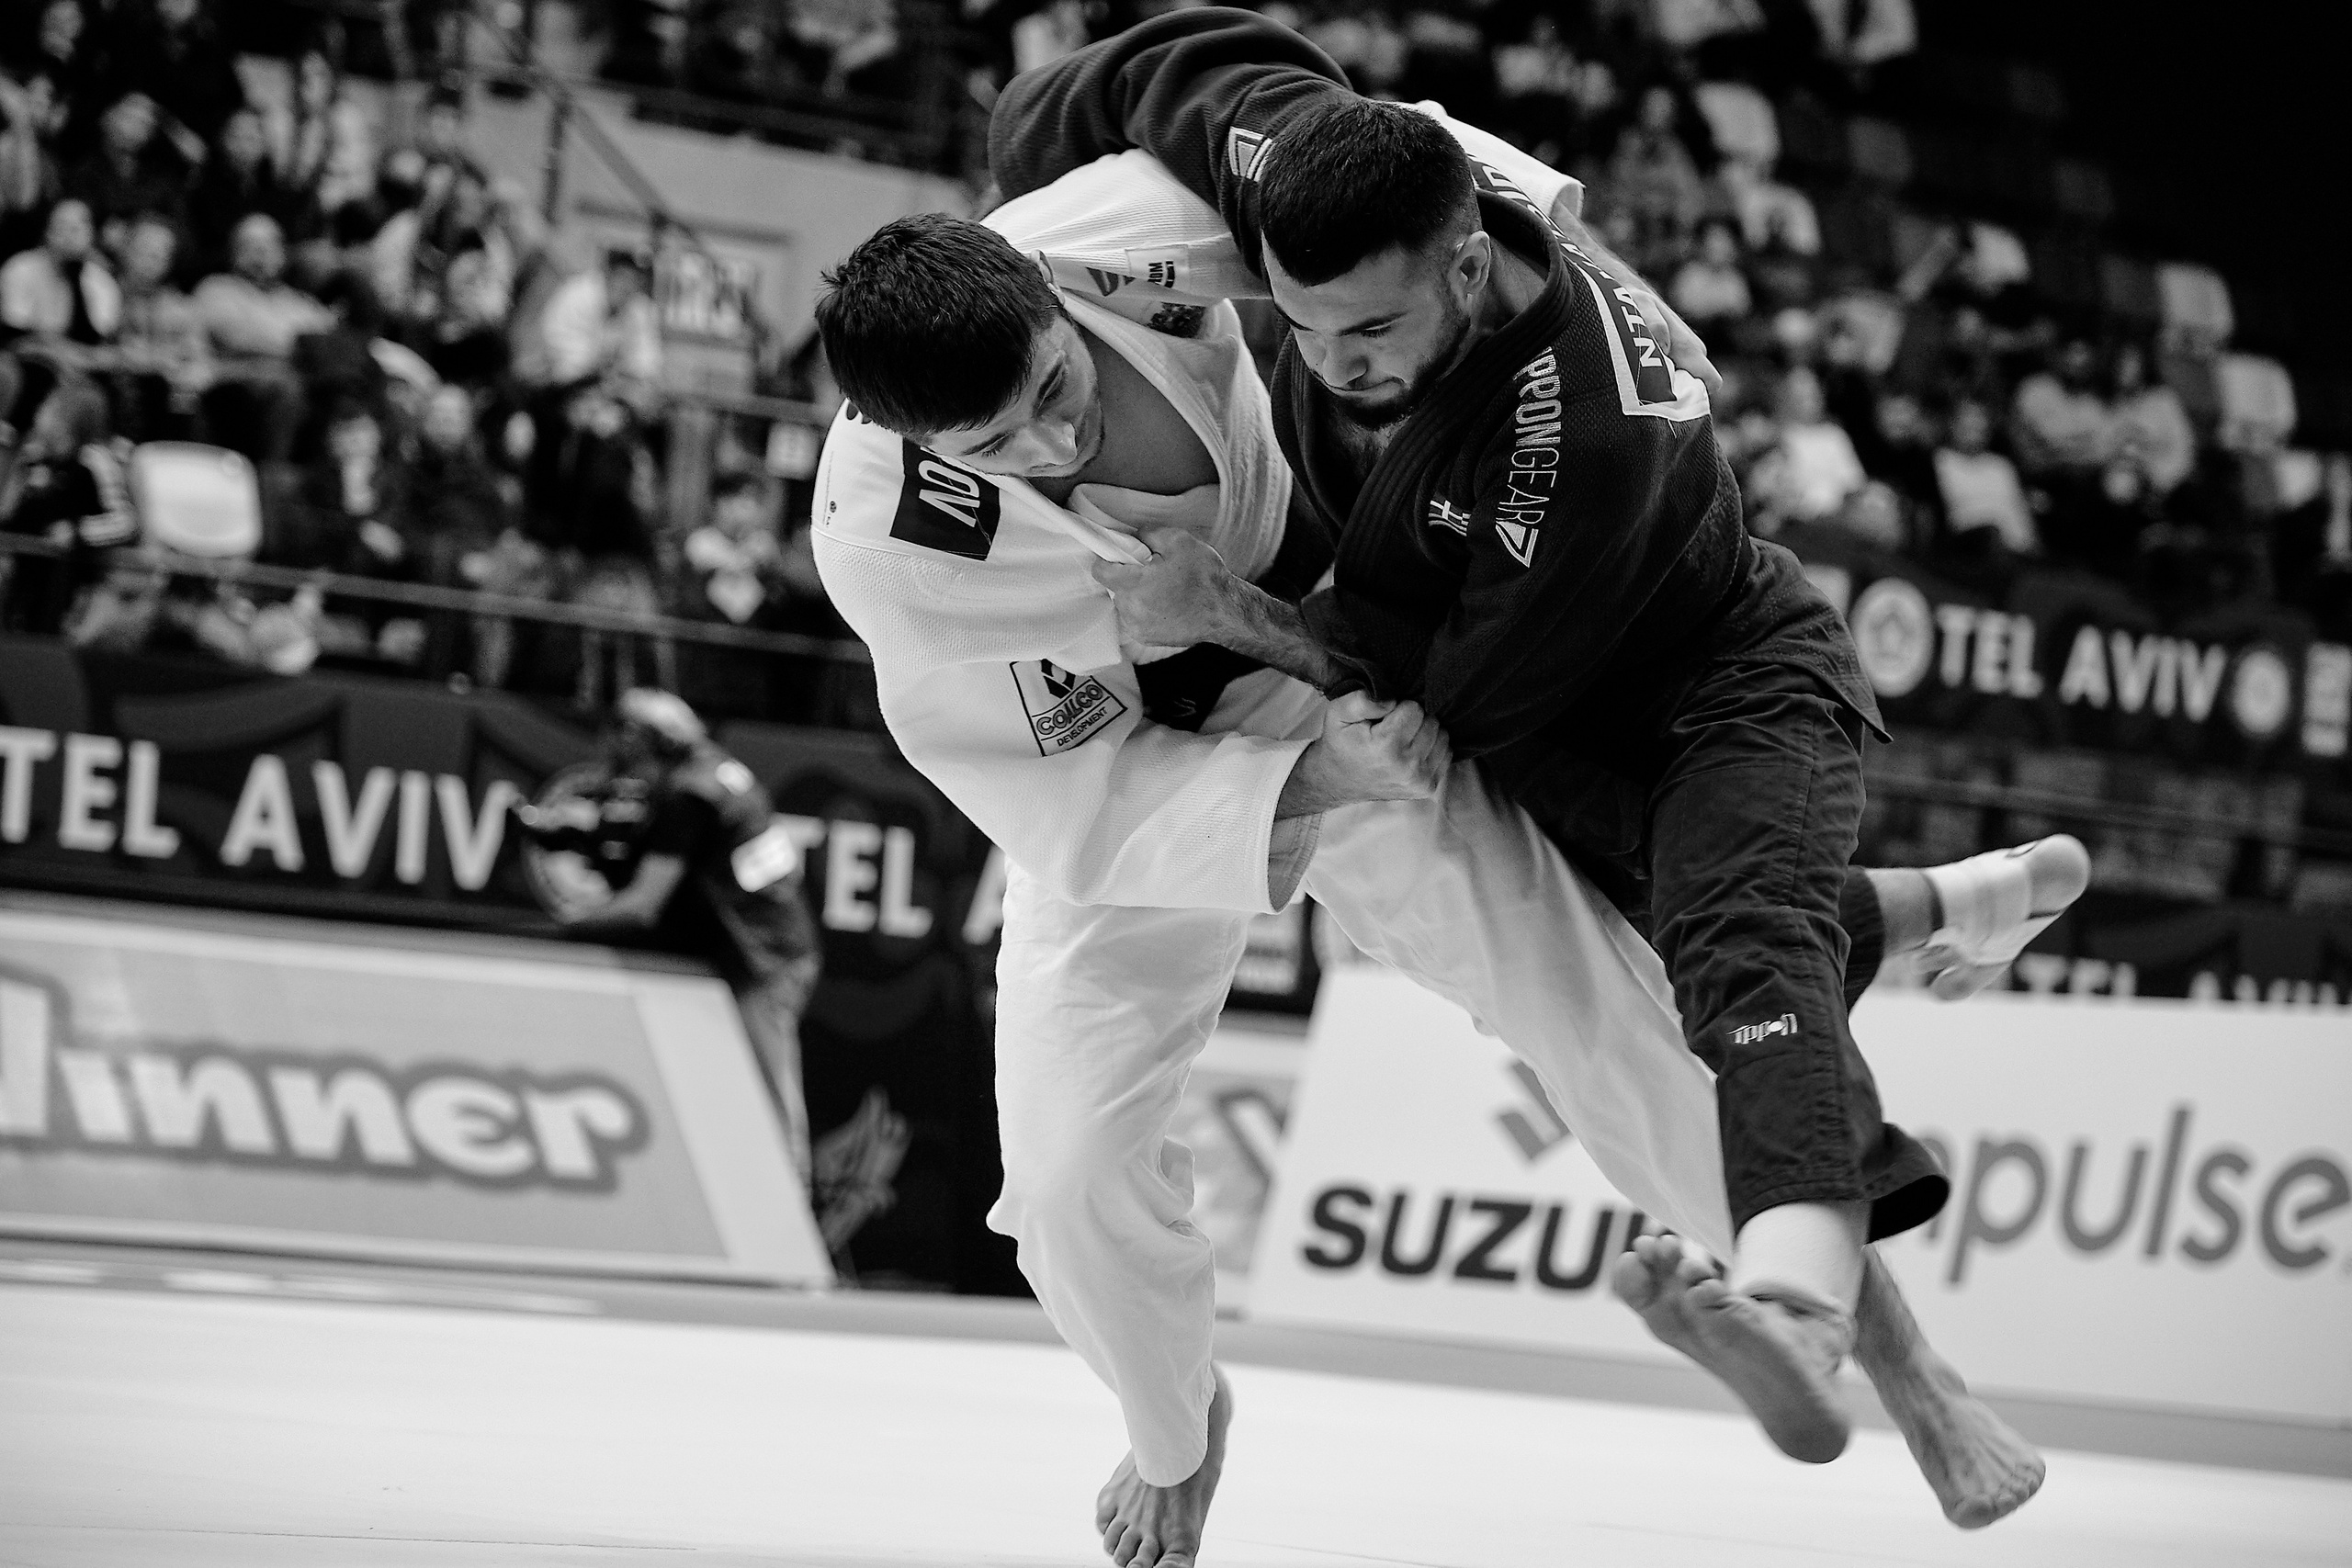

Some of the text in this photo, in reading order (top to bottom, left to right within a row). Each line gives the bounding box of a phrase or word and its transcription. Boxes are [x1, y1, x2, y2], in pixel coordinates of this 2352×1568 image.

[1936, 603, 2043, 698] TEL
[2059, 625, 2227, 721] AVIV
[0, 724, 519, 892] TEL AVIV
[1303, 1187, 1646, 1291] SUZU
